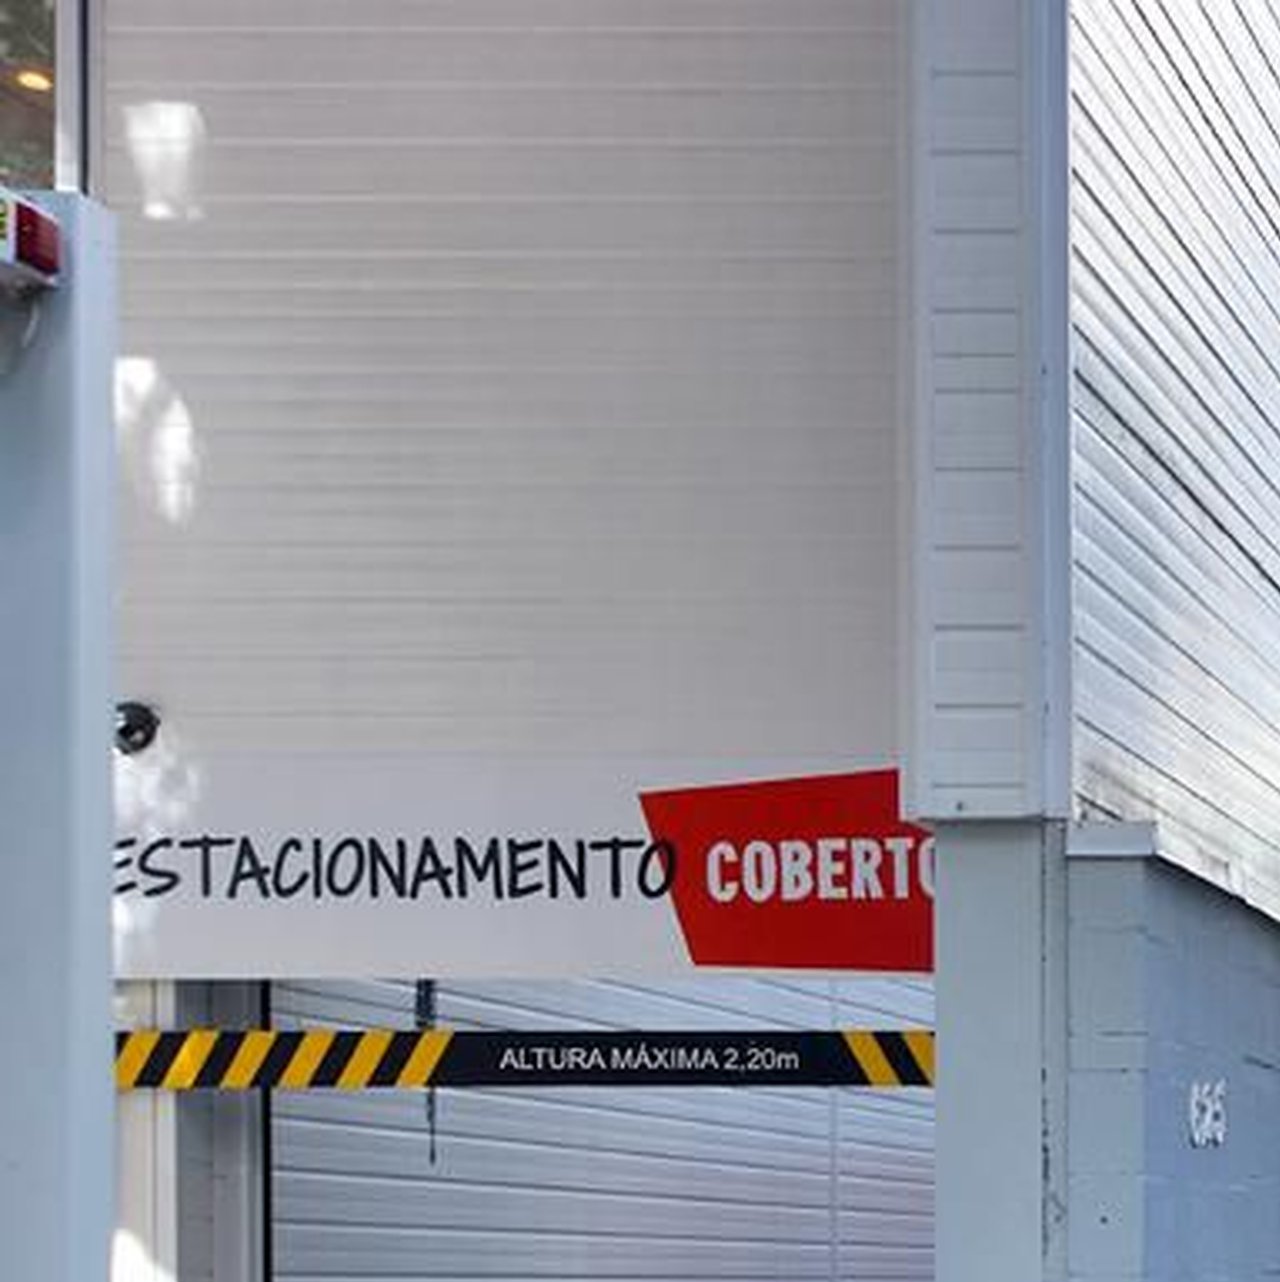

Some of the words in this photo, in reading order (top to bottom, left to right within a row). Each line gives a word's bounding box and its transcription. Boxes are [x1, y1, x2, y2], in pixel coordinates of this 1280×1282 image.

[114, 836, 676, 899] ESTACIONAMENTO
[500, 1049, 606, 1070] ALTURA
[610, 1042, 719, 1070] MÁXIMA
[723, 1048, 799, 1073] 2,20m
